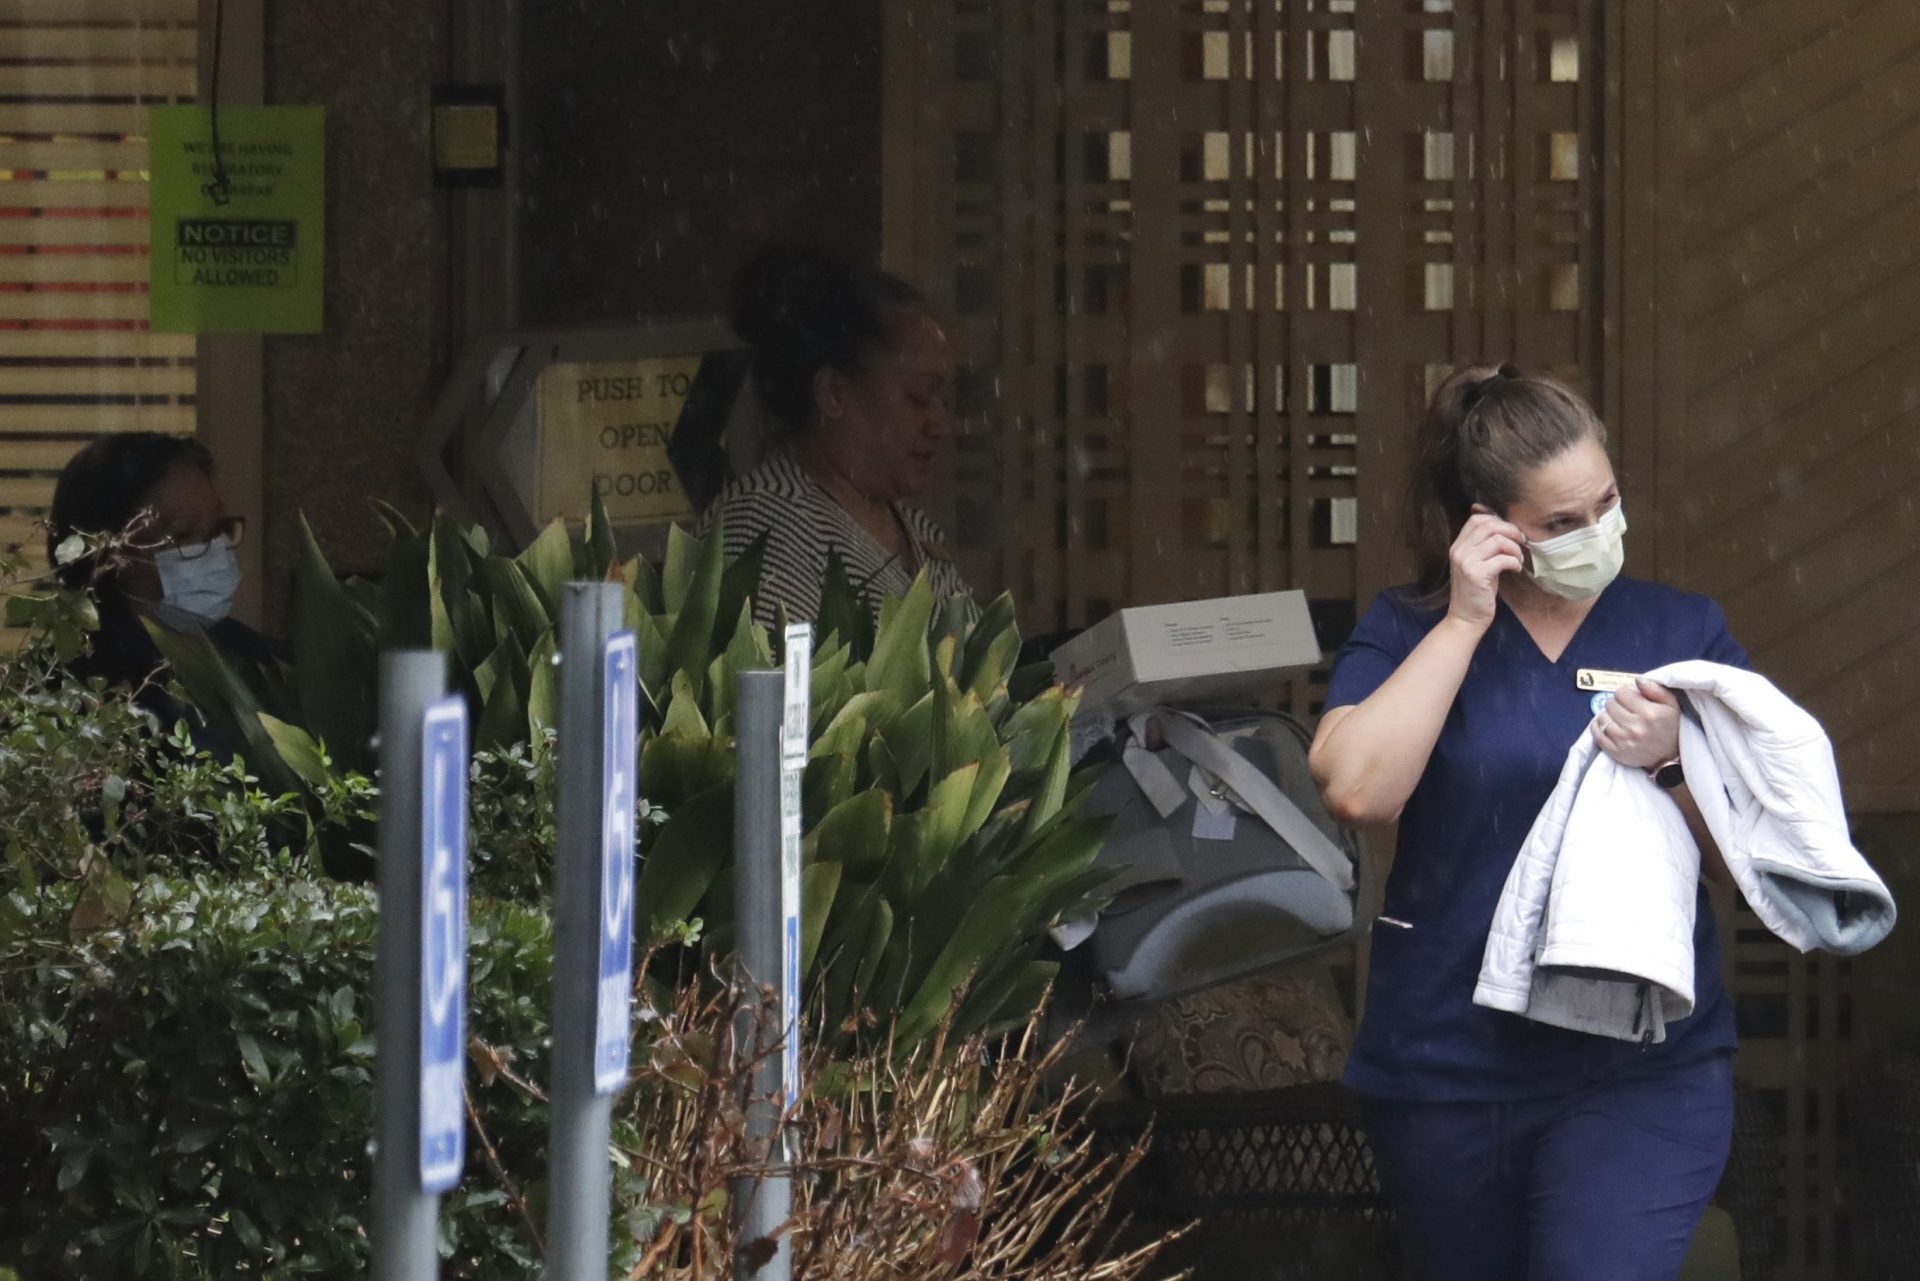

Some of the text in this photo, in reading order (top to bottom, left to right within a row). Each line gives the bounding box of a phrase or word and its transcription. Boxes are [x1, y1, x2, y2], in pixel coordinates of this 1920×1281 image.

[183, 143, 206, 154] WE
[183, 225, 290, 244] NOTICE
[181, 249, 290, 265] NO VISITORS
[193, 269, 279, 286] ALLOWED
[577, 372, 690, 402] PUSH TO
[600, 423, 672, 450] OPEN
[593, 470, 672, 497] DOOR
